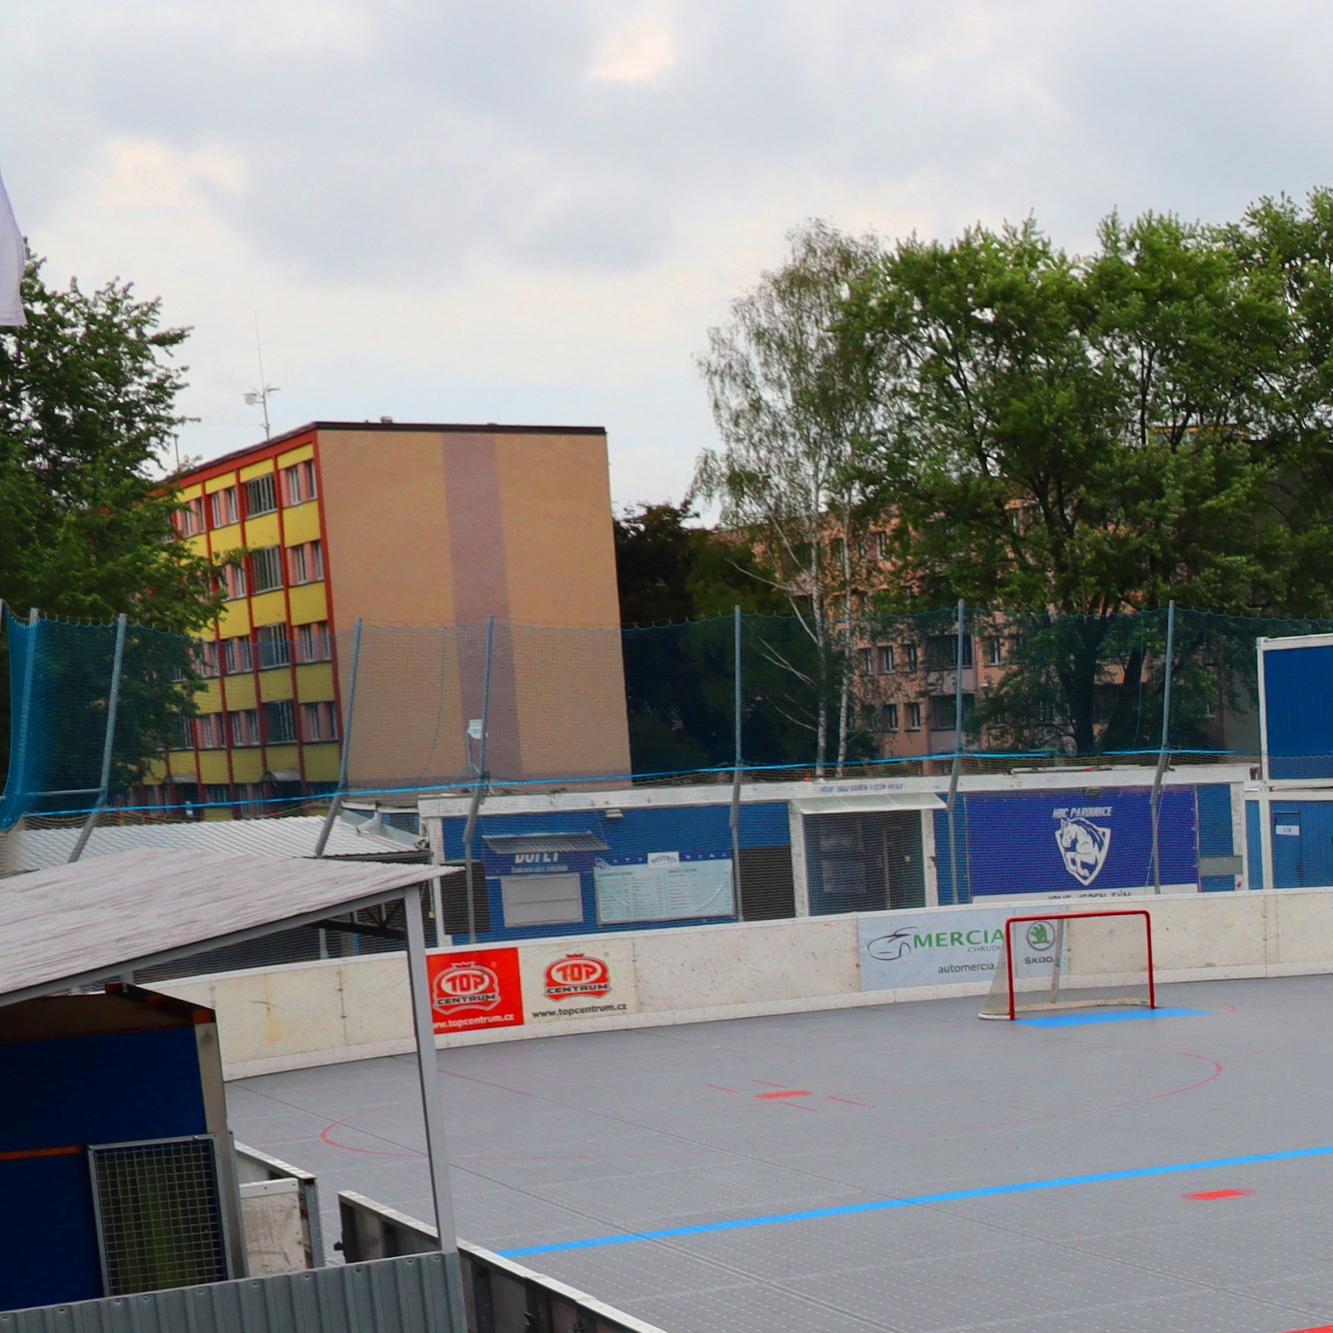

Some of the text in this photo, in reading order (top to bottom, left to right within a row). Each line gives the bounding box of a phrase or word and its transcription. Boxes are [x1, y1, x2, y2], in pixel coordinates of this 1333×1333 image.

[914, 928, 1005, 949] MERCIA
[967, 945, 1001, 953] CHRUDI
[556, 962, 598, 982] TOP
[445, 974, 485, 992] TOP
[546, 984, 610, 995] CENTRUM
[436, 993, 497, 1005] CENTRUM
[532, 1003, 627, 1018] www.topcentrum.cz
